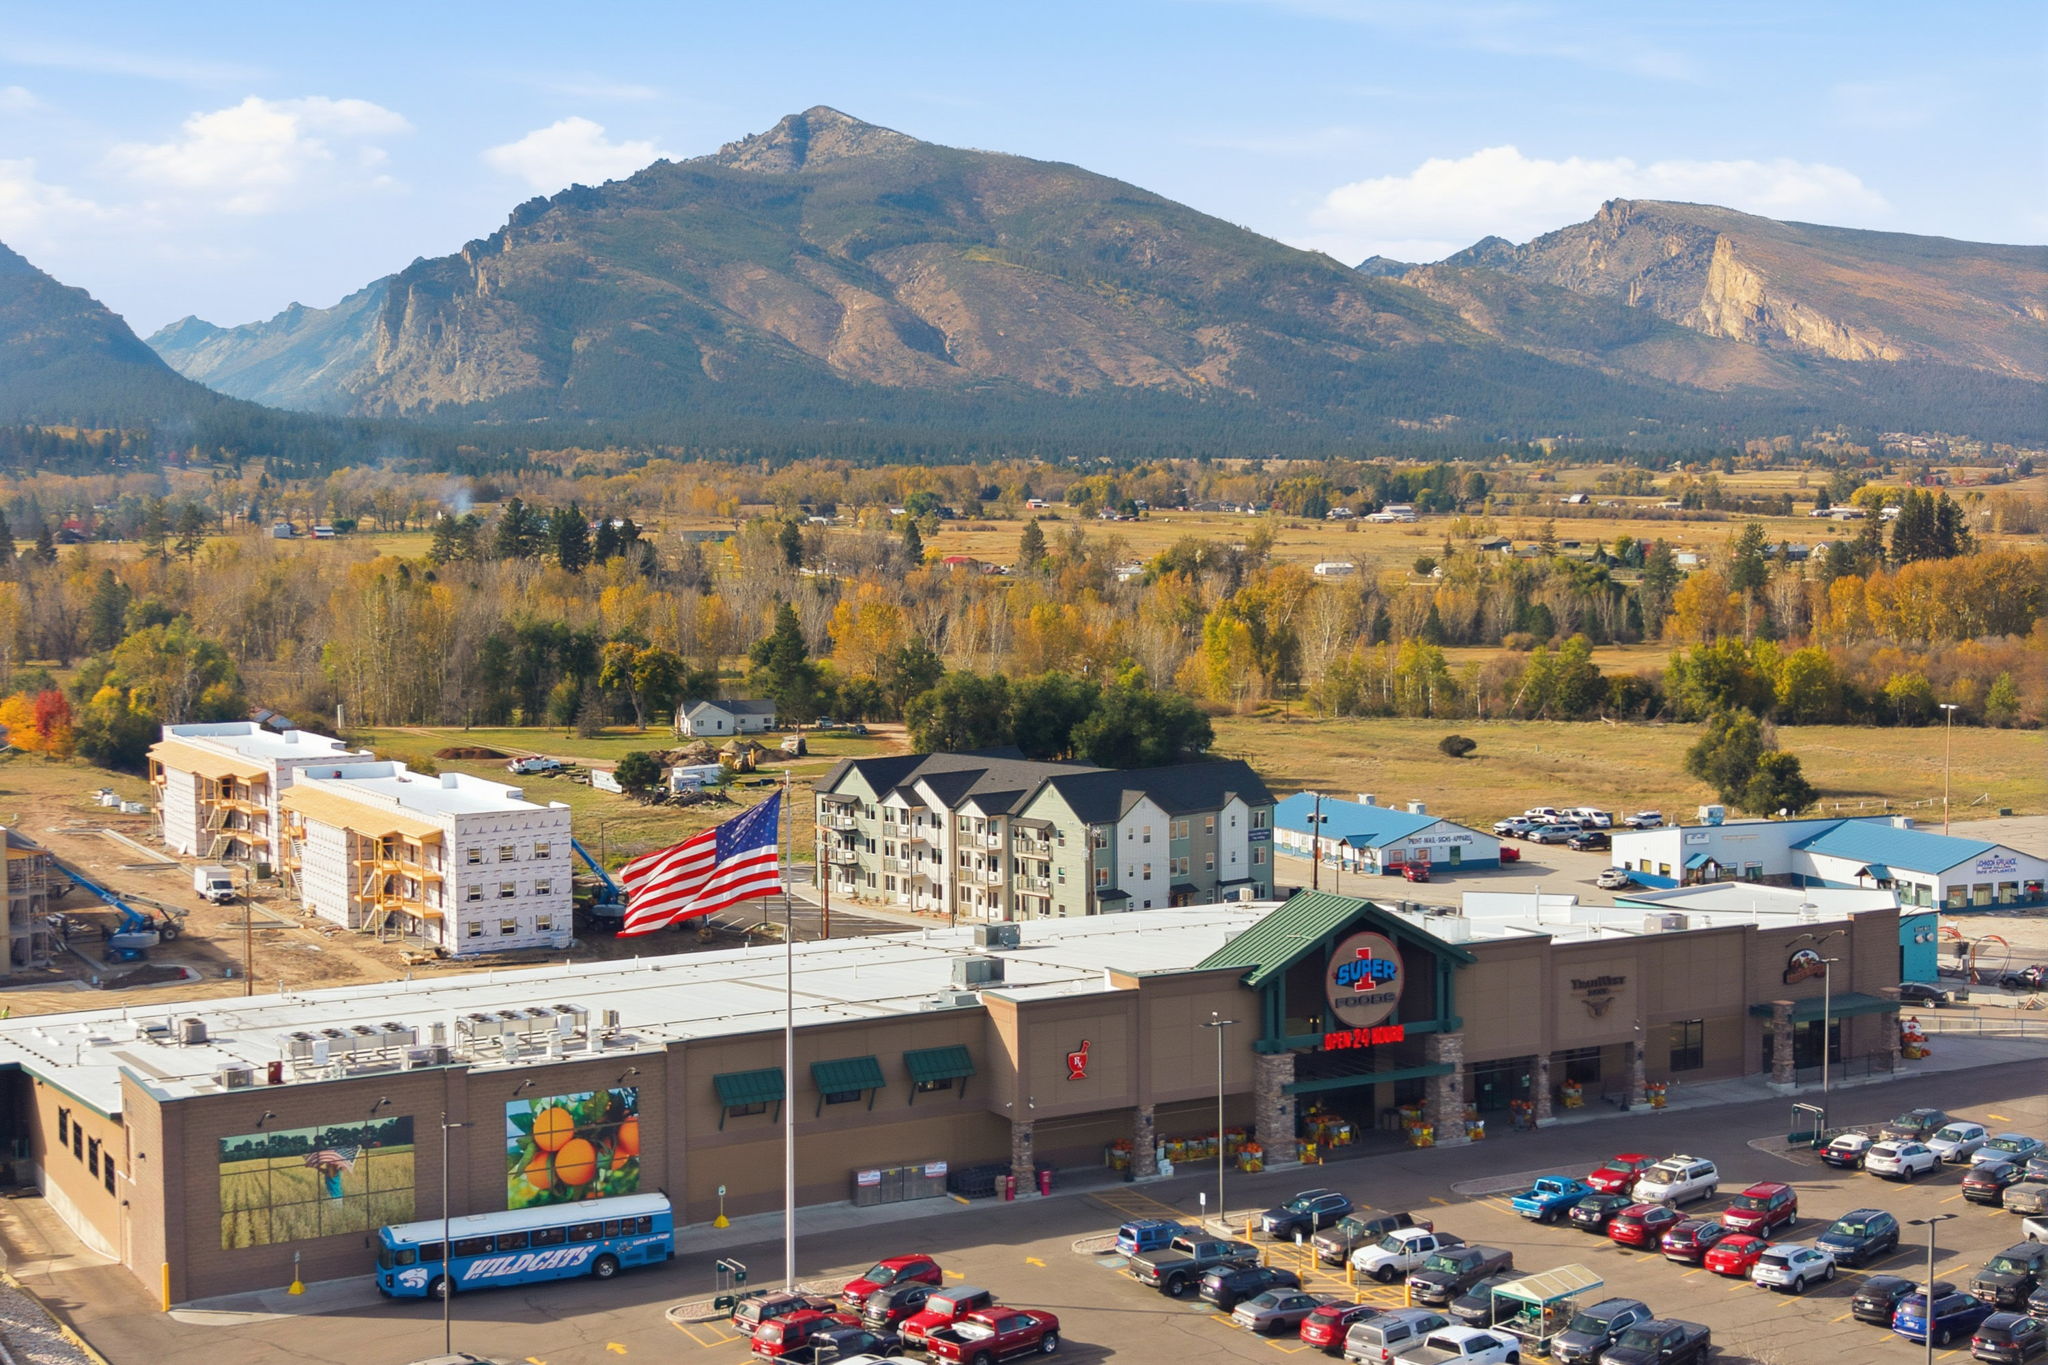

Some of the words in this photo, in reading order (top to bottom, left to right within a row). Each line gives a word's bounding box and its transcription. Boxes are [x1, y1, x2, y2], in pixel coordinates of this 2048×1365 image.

[1335, 958, 1397, 986] SUPER
[1334, 992, 1396, 1009] FOODS
[1323, 1031, 1352, 1051] OPEN
[1353, 1027, 1370, 1048] 24
[1371, 1024, 1405, 1045] HOURS
[462, 1244, 597, 1281] WILDCATS
